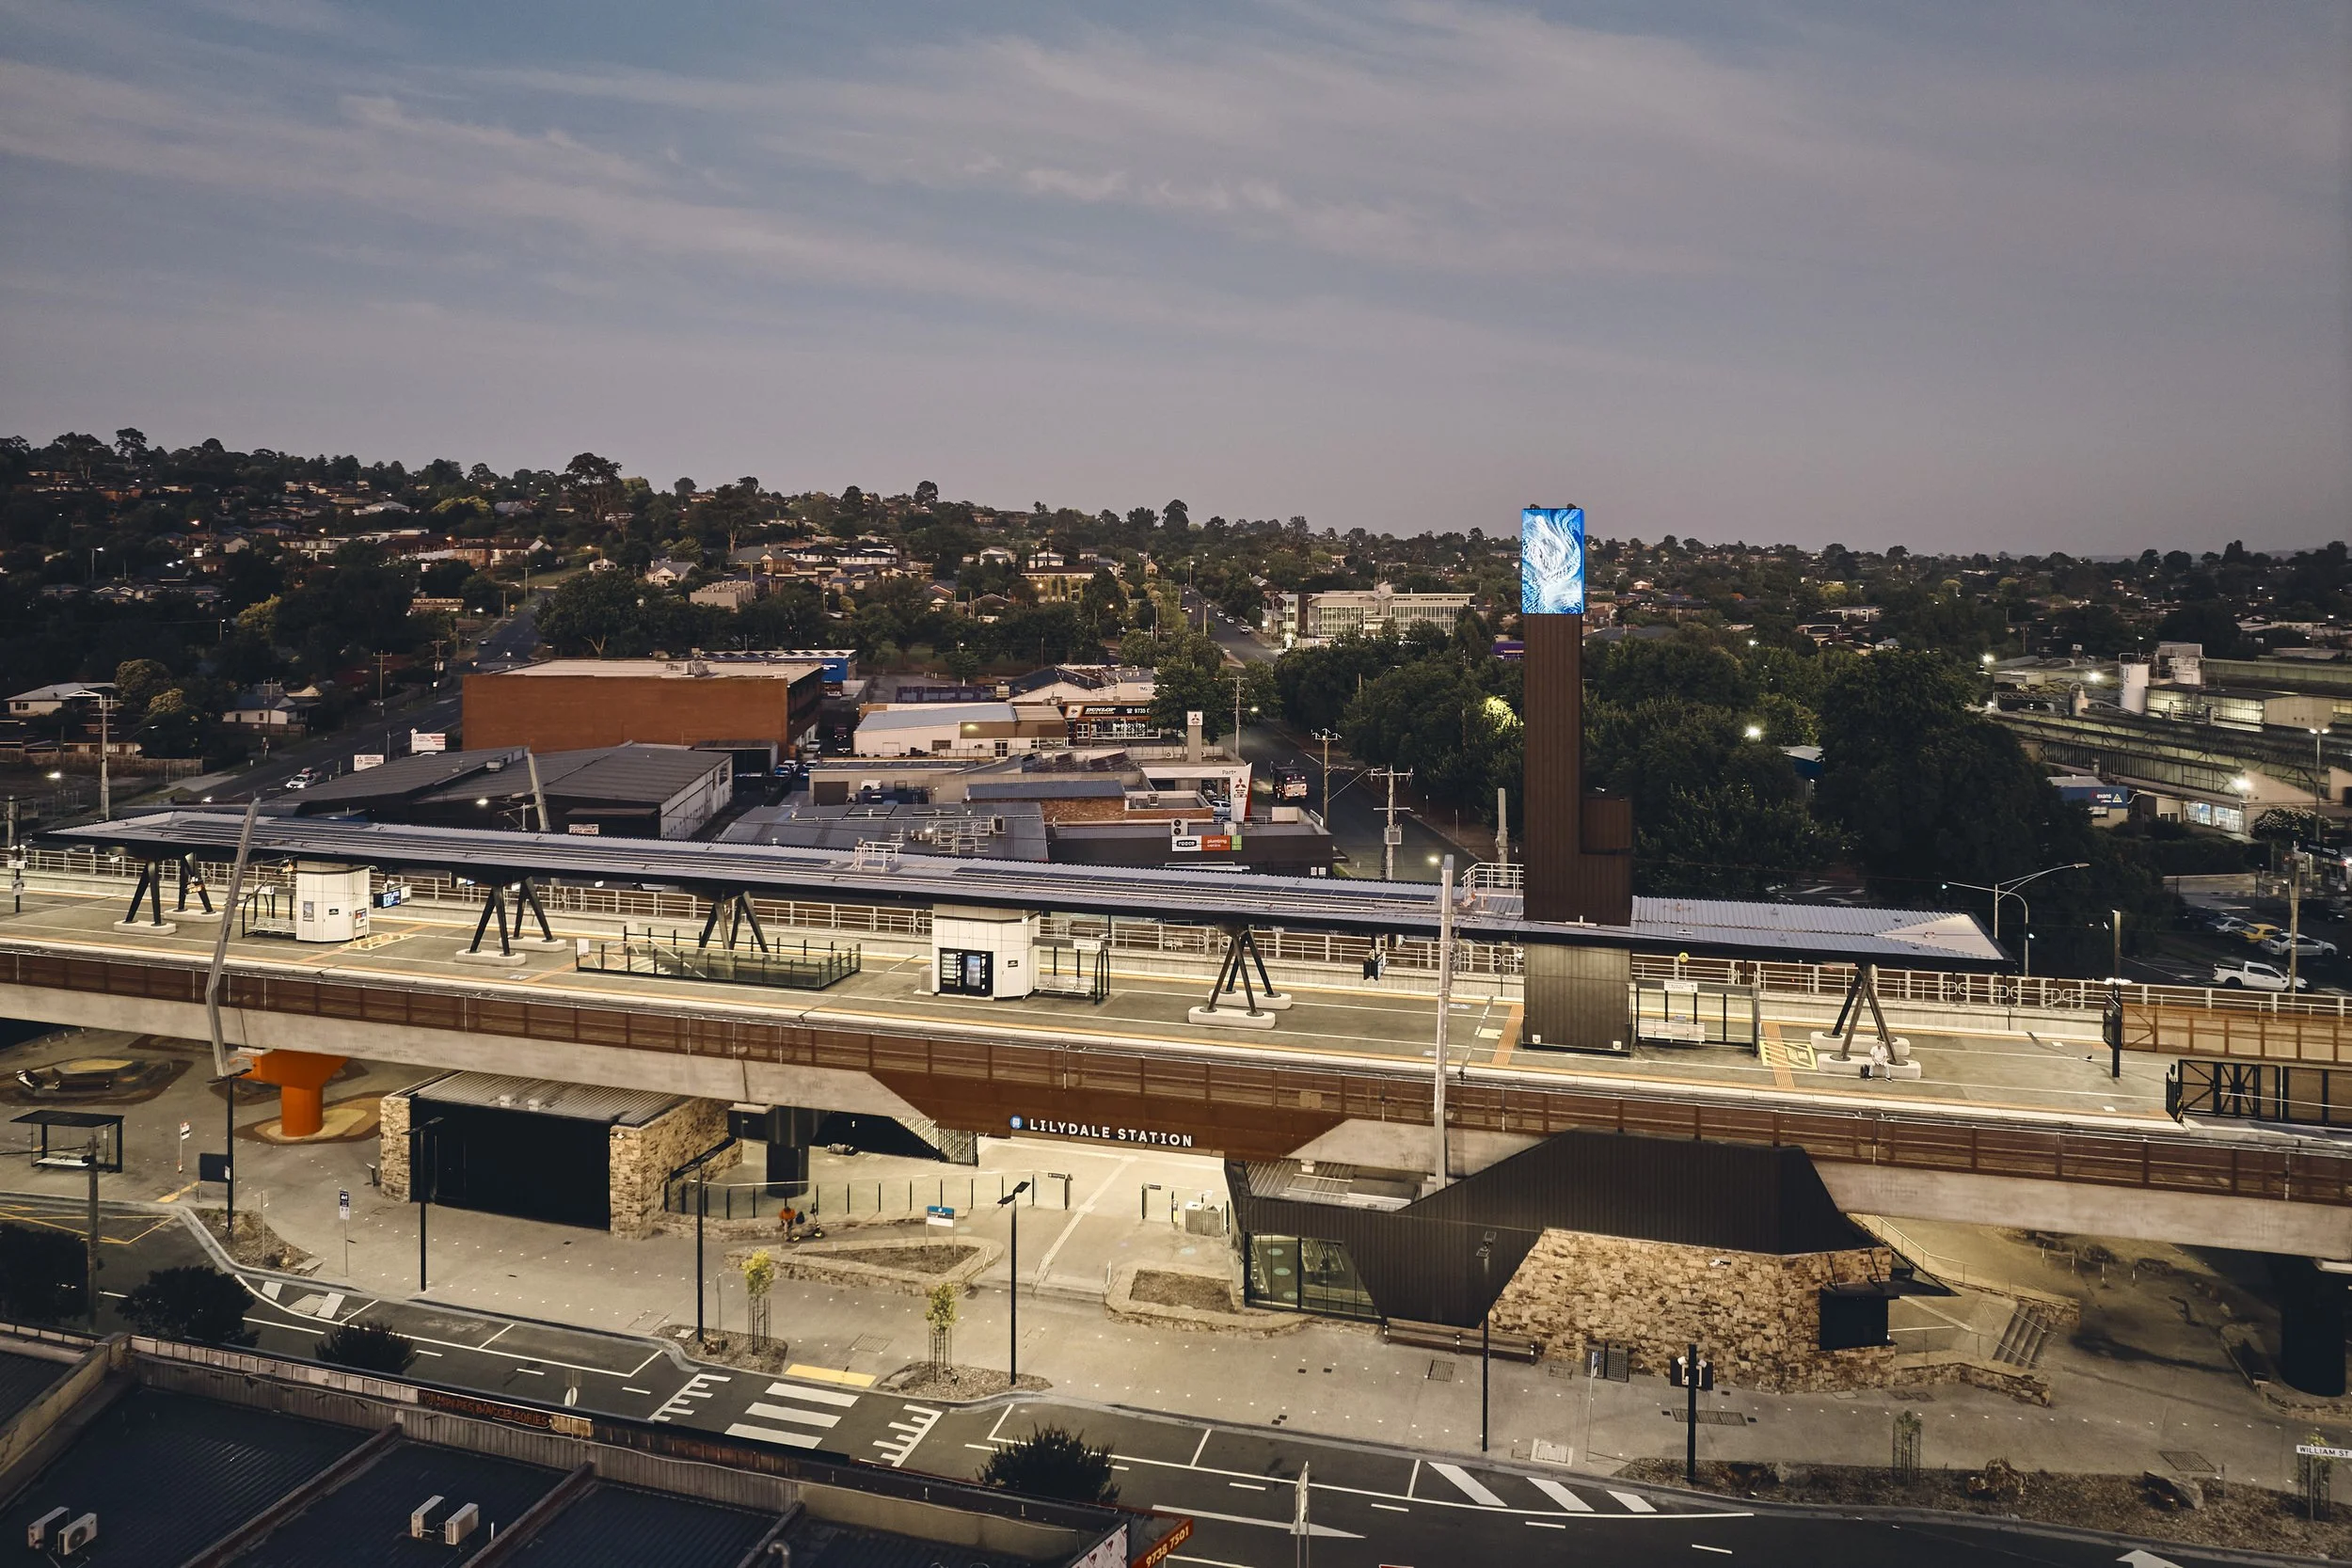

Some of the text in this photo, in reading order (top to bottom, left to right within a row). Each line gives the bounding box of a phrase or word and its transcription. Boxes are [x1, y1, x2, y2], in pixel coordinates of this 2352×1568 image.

[1029, 1118, 1193, 1148] LILYDALE STATION
[2299, 1446, 2336, 1456] WILLIAM
[1145, 1525, 1189, 1568] 9738 7501
